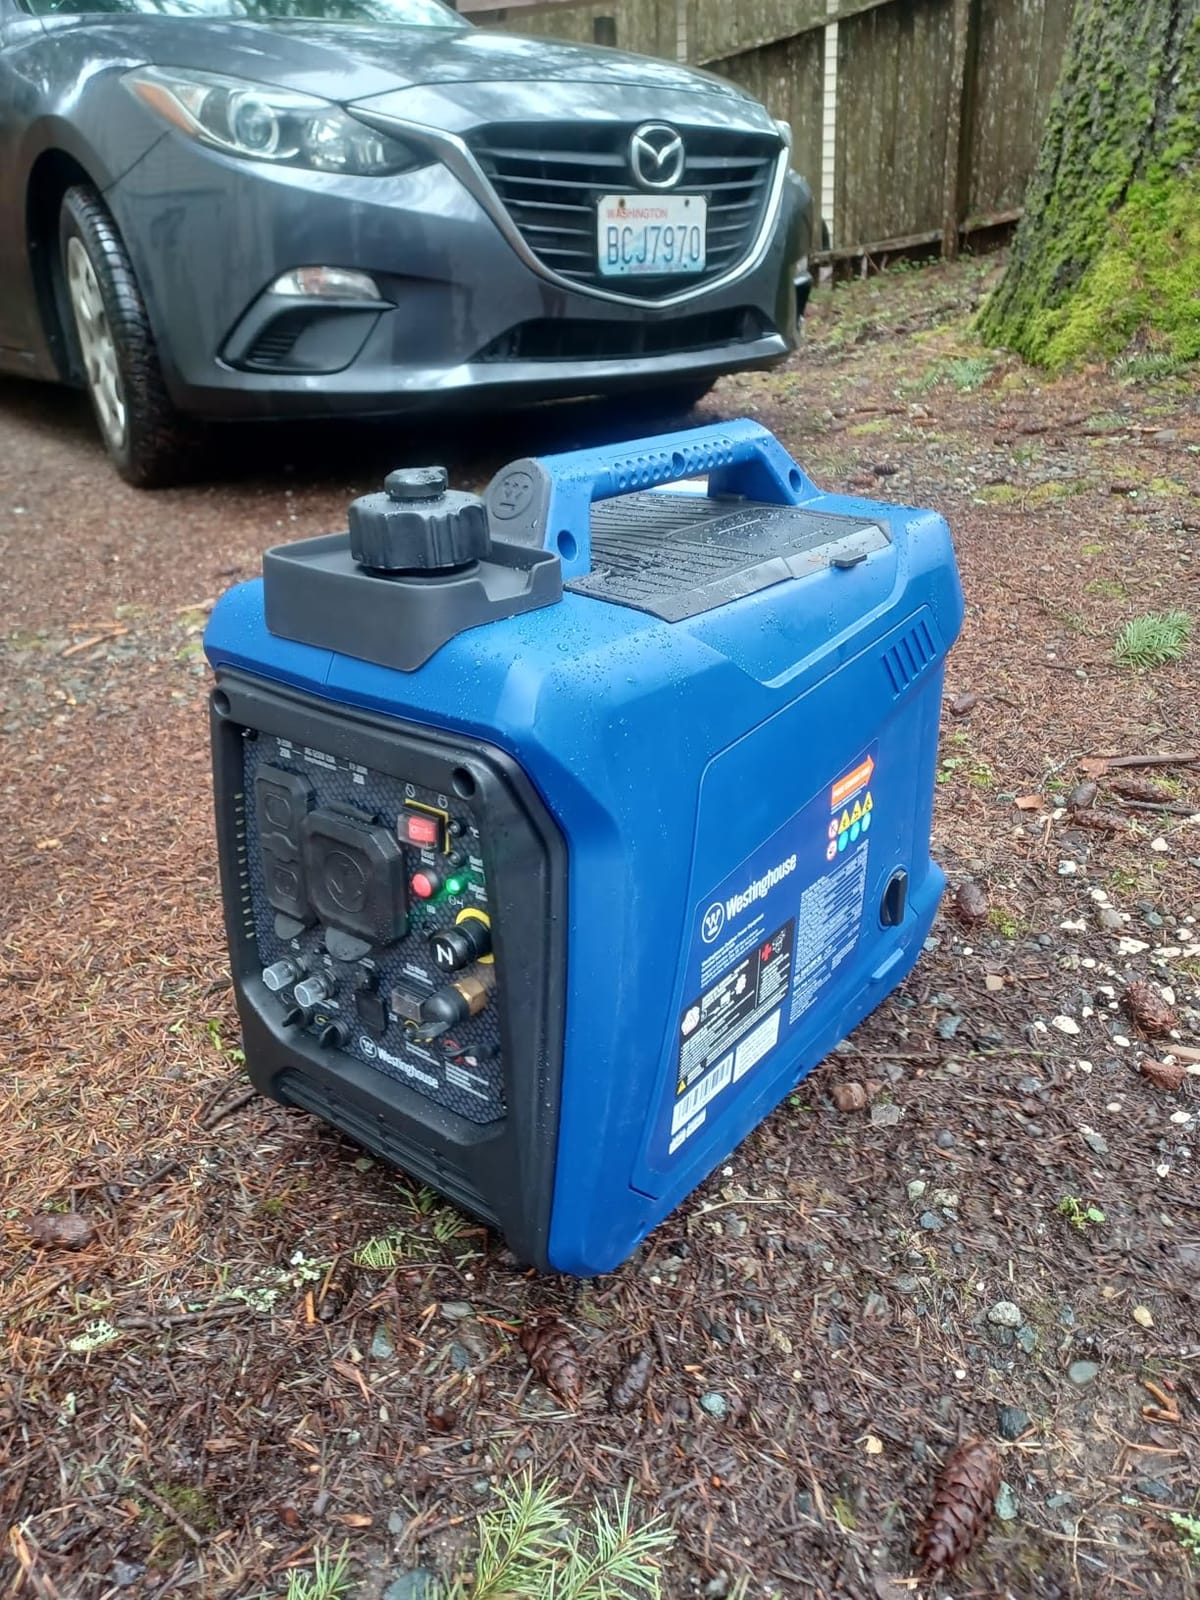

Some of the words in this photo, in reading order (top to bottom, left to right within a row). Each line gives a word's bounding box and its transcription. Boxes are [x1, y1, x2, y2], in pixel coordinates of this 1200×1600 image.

[606, 207, 668, 219] WASHINGTON
[607, 226, 700, 265] BCJ7970
[726, 853, 797, 921] Westinghouse
[436, 943, 453, 966] N
[377, 1046, 439, 1089] Westinghouse
